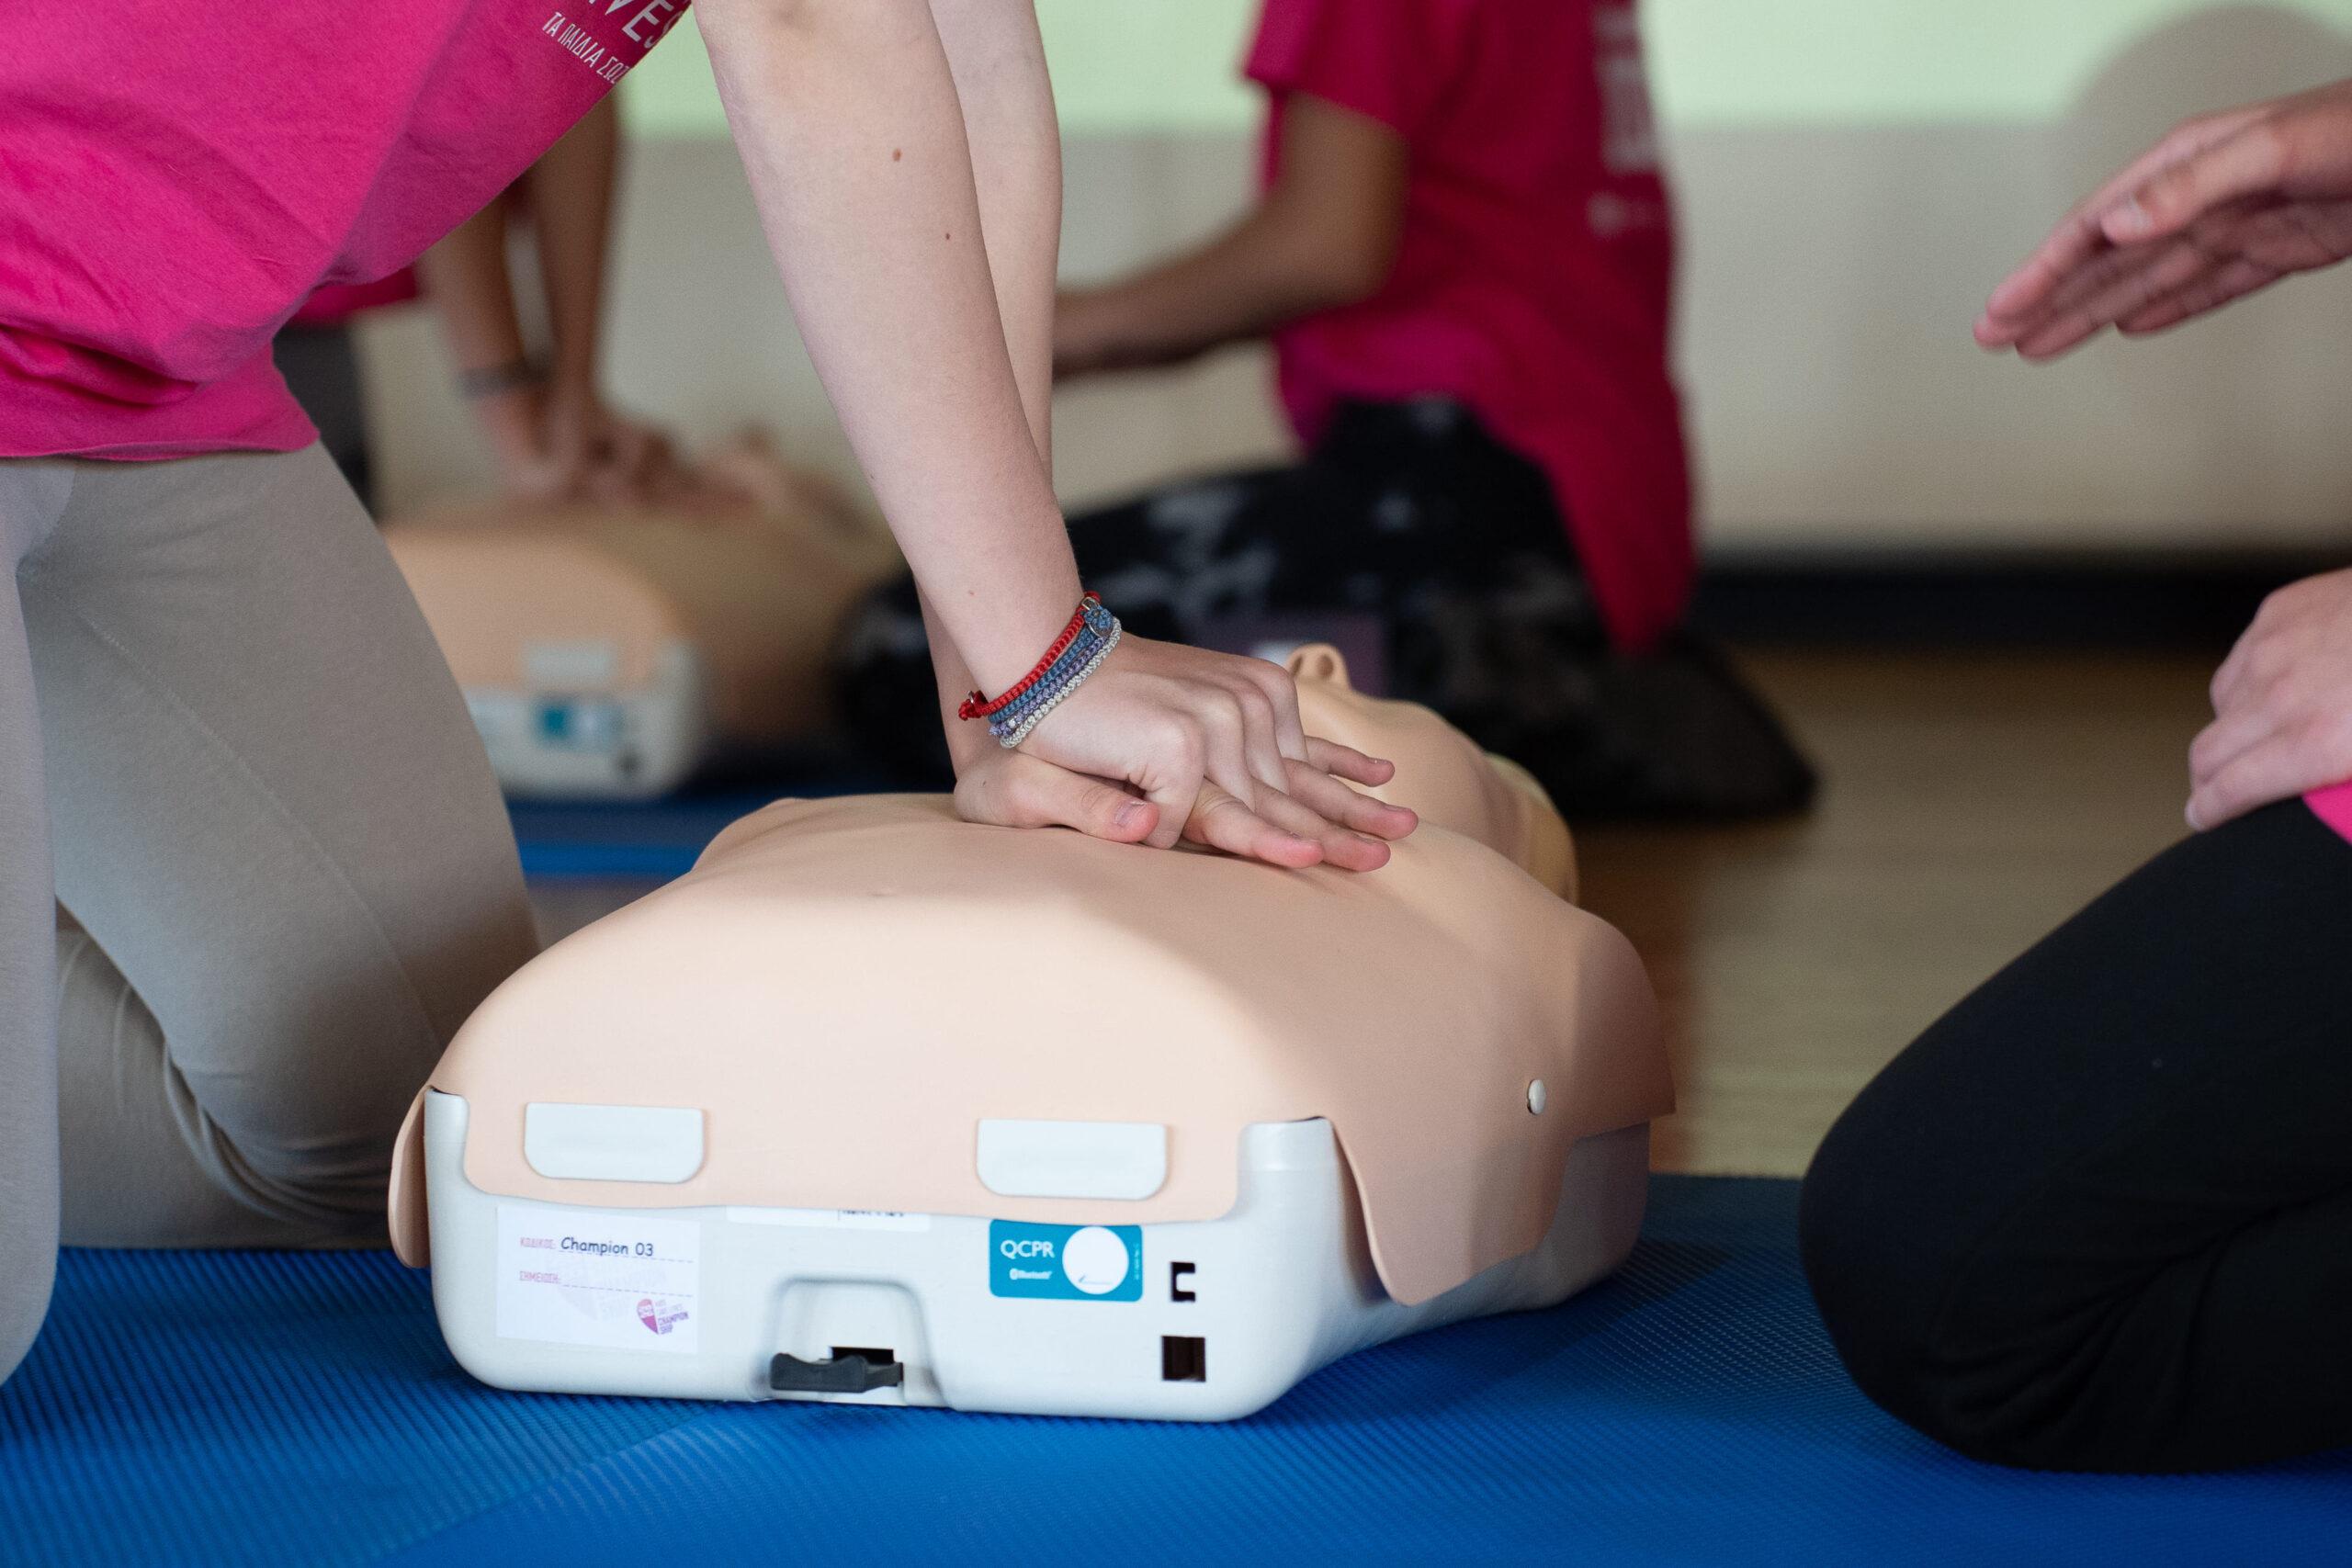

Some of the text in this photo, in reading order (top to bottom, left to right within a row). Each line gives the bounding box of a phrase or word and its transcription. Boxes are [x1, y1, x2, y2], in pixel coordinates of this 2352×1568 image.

[542, 12, 566, 37] ΤΑ
[558, 24, 605, 68] ΠΑΙΔΙΑ
[560, 1236, 654, 1257] Champion 03
[1000, 1240, 1055, 1259] QCPR
